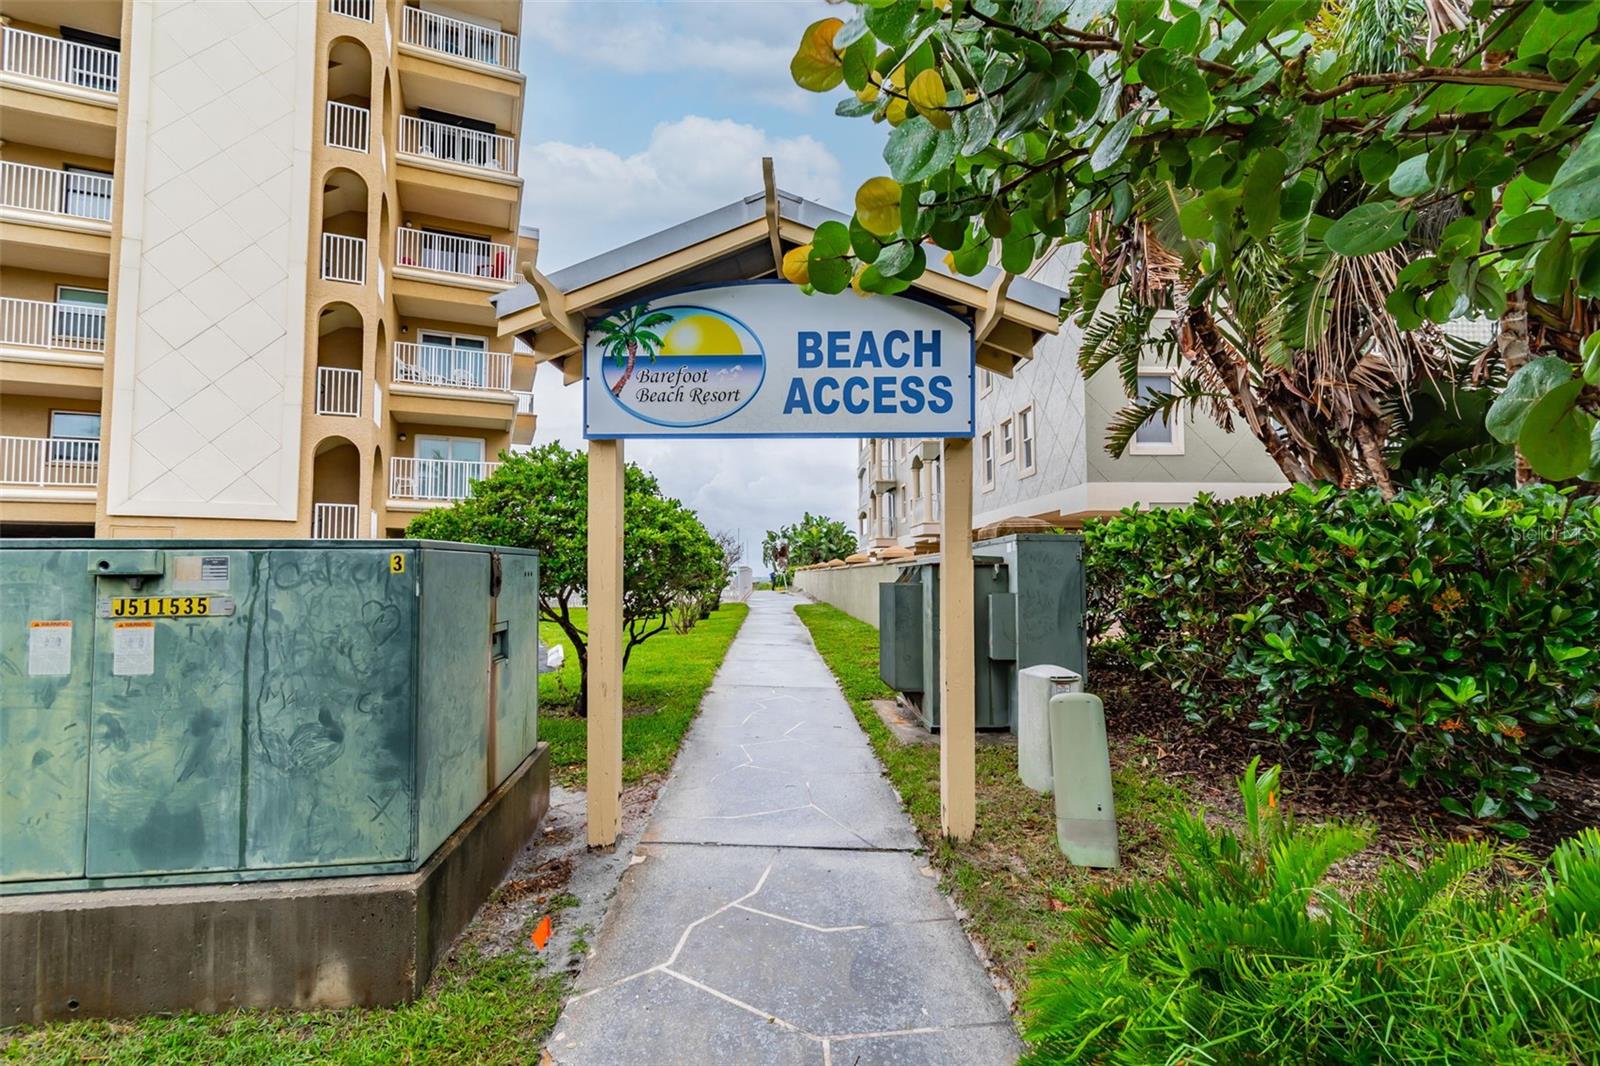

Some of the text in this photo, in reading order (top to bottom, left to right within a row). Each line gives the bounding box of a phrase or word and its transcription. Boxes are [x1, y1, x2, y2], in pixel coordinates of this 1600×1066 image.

[797, 330, 941, 369] BEACH
[636, 365, 708, 389] Barefoot
[636, 386, 741, 406] Beach Resort
[783, 375, 953, 415] ACCESS
[392, 555, 403, 572] 3
[114, 597, 208, 616] J511535
